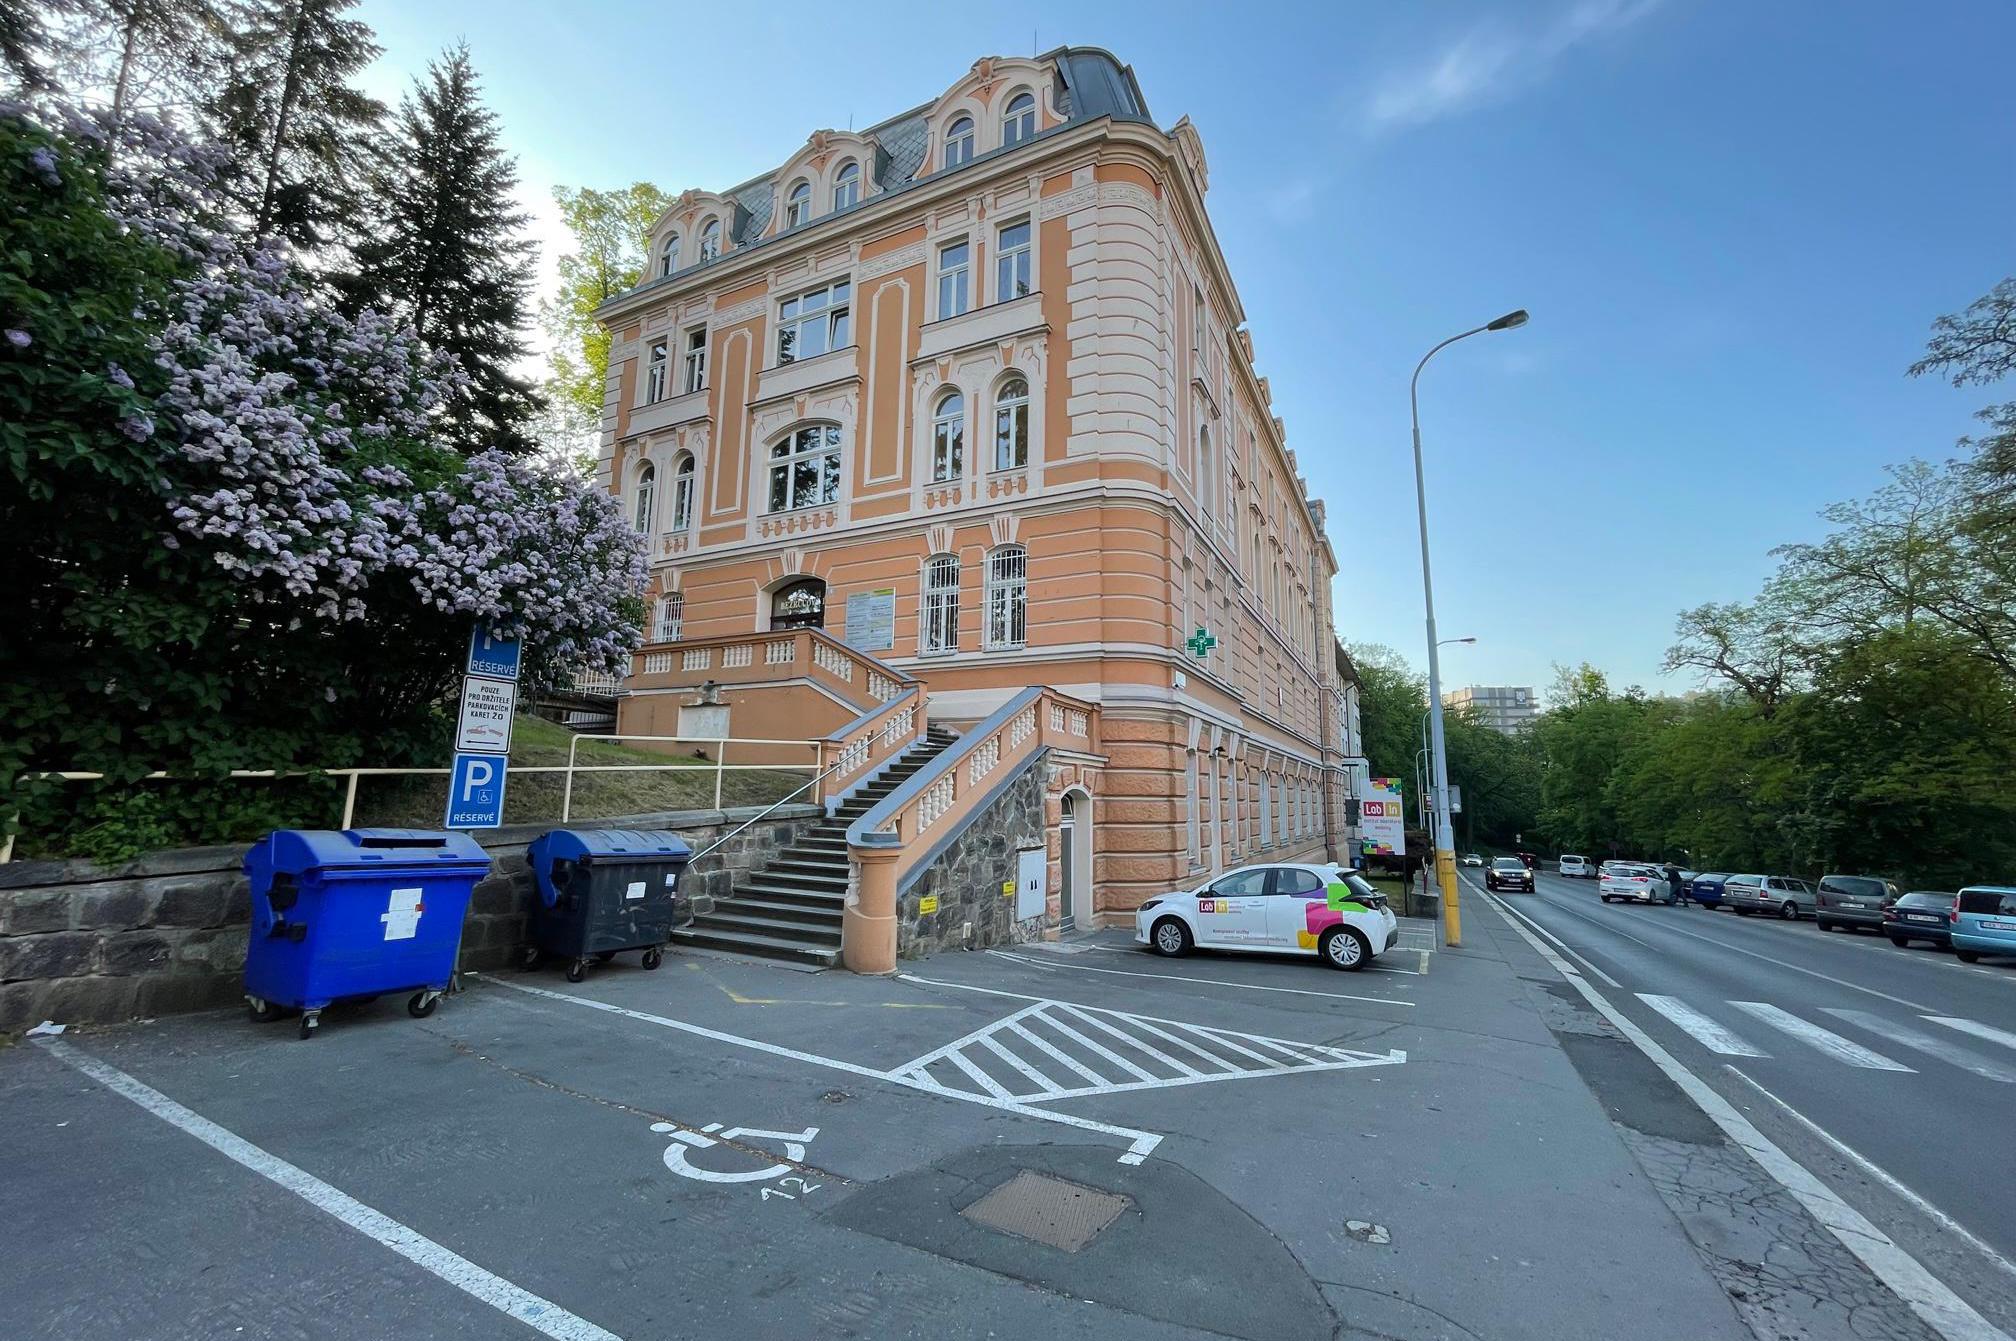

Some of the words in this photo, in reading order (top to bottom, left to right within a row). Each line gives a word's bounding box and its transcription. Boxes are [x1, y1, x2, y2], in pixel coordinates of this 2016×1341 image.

[471, 659, 516, 675] RÉSERVÉ
[480, 686, 500, 695] POUZE
[481, 694, 510, 705] DRŽITELE
[467, 701, 509, 713] PARKOVACÍCH
[470, 711, 490, 719] KARET
[463, 760, 493, 801] P
[1366, 804, 1382, 815] Lab
[453, 812, 495, 822] RÉSERVÉ
[1201, 902, 1214, 912] Lab
[760, 1177, 822, 1201] 12
